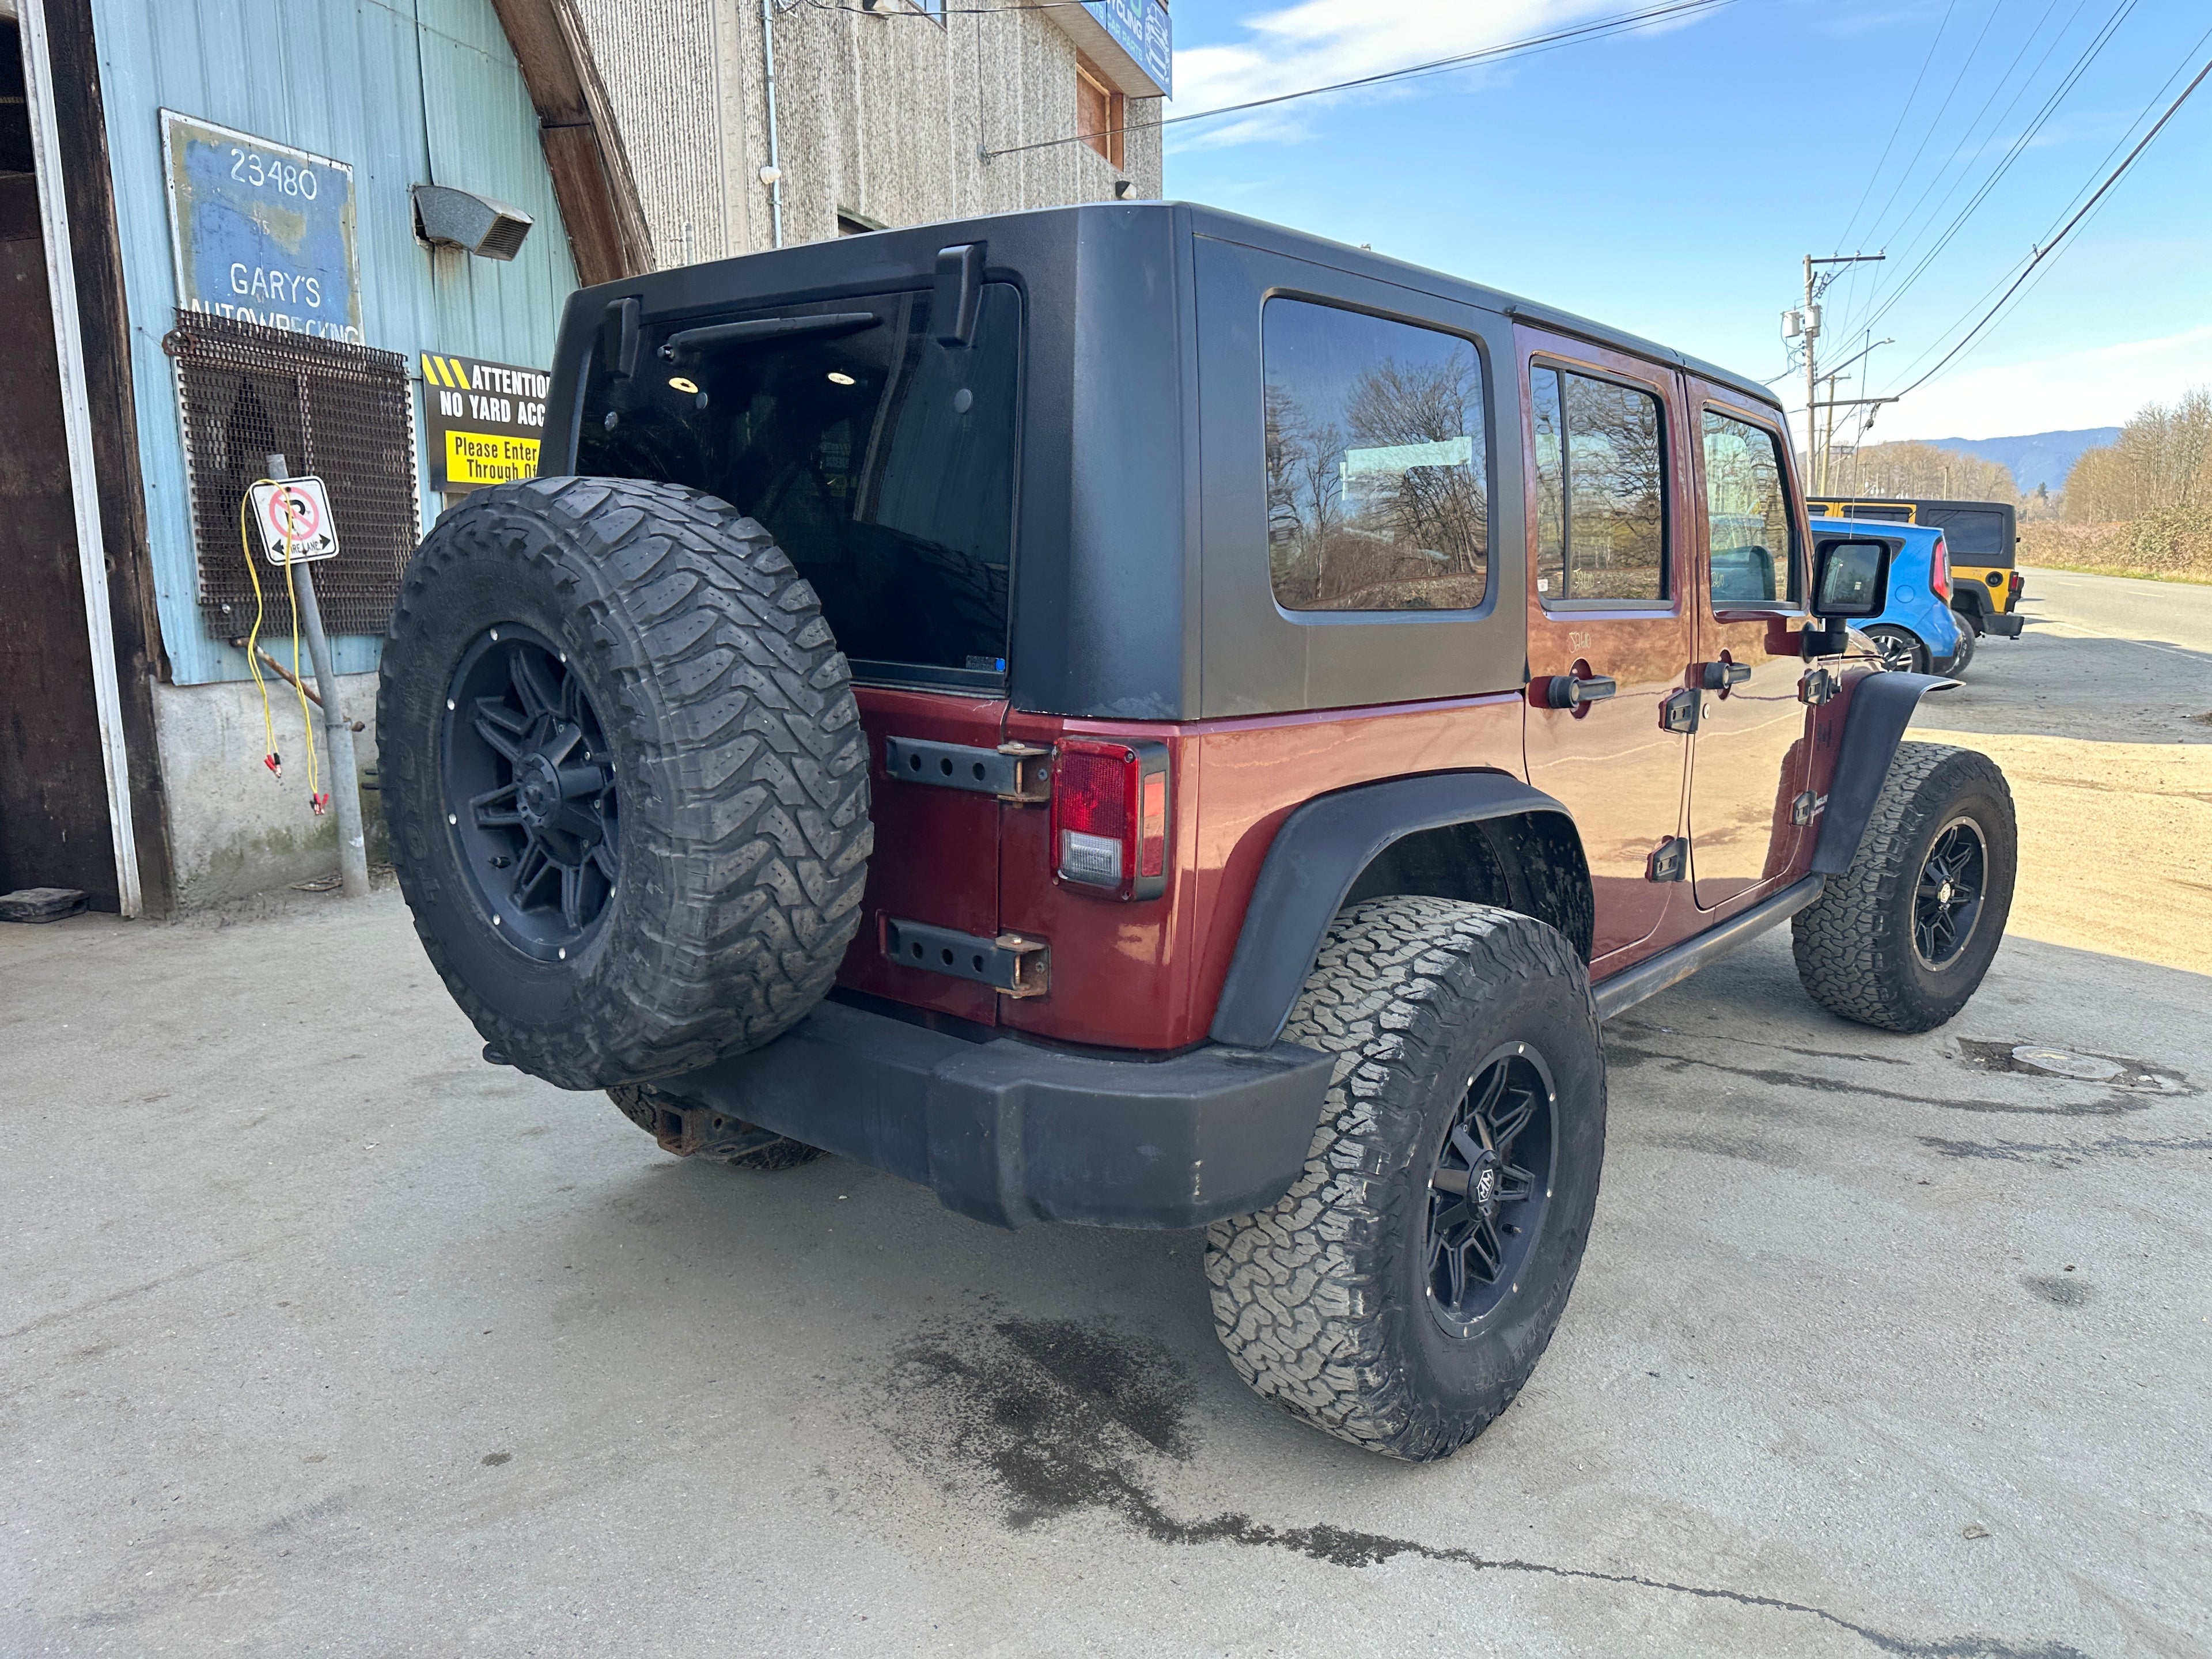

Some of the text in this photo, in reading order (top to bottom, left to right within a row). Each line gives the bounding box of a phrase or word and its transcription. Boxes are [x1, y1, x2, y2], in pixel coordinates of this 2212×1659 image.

[1107, 0, 1143, 41] YCLING
[1107, 12, 1121, 39] CAR
[1122, 29, 1143, 62] PARTS
[230, 147, 317, 200] 23480
[230, 262, 321, 308] GARY'S
[440, 390, 546, 427] NO YARD ACC
[455, 436, 537, 461] Please Enter
[467, 459, 537, 482] Through Of
[289, 543, 301, 554] IRE
